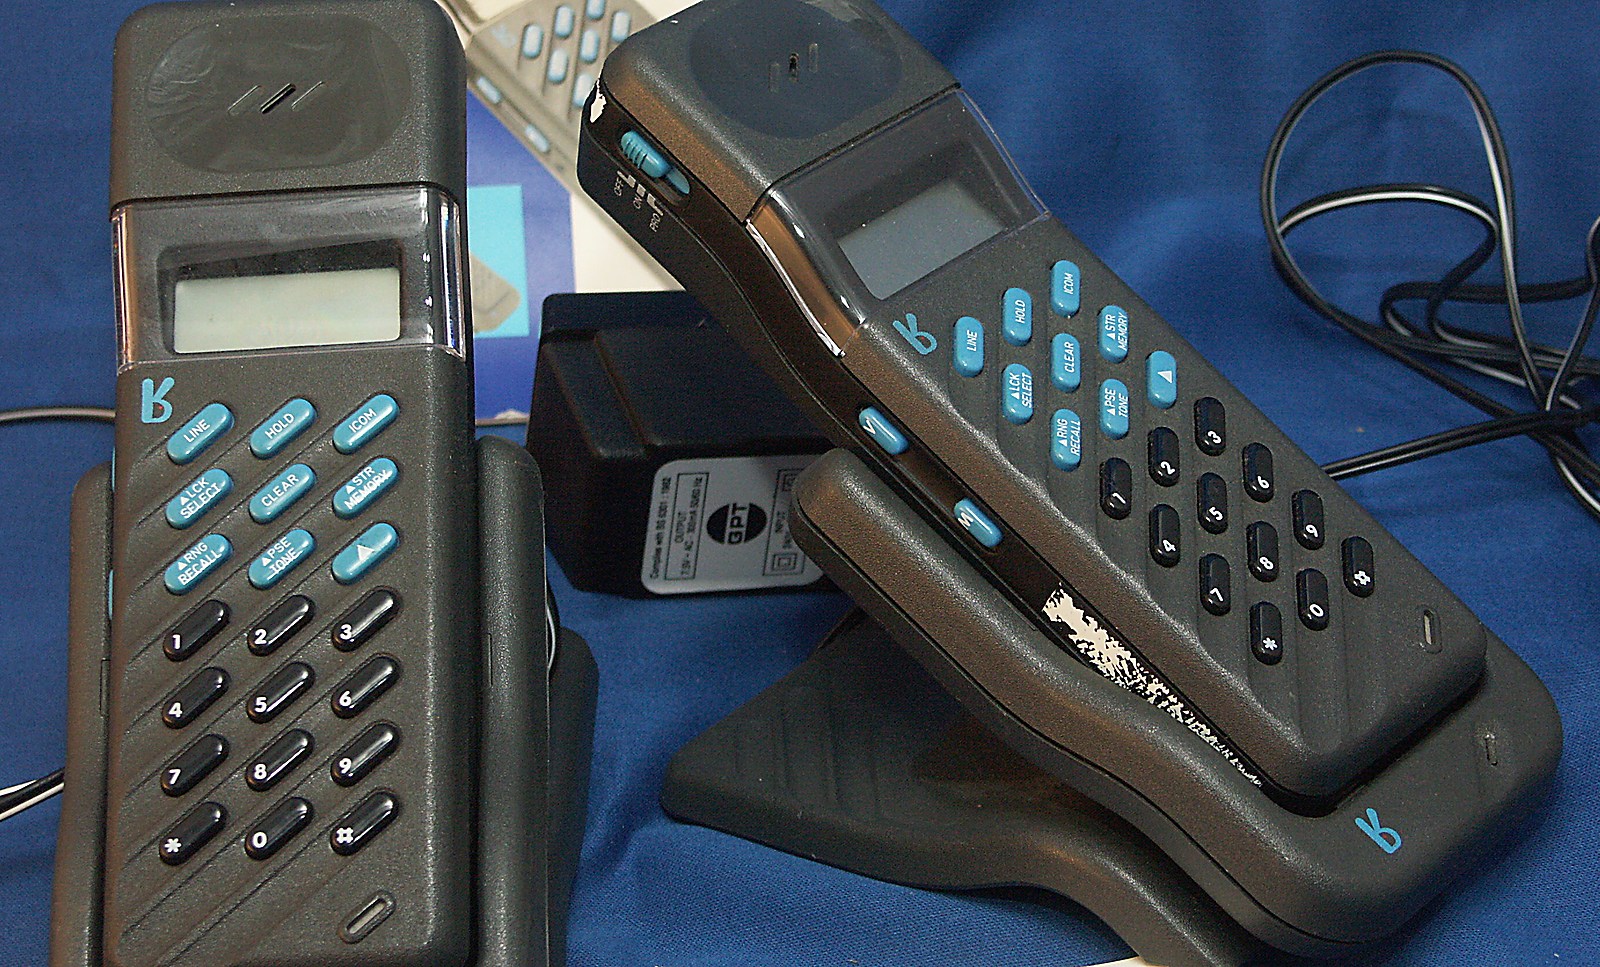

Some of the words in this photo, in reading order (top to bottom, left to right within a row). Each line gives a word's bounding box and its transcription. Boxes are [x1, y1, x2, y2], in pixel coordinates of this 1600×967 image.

[1063, 272, 1074, 295] ICOM
[1015, 299, 1026, 324] HOLD
[1117, 312, 1129, 351] MEMORY
[966, 330, 978, 352] LINE
[1064, 341, 1075, 373] CLEAR
[1022, 373, 1033, 408] SELECT
[1118, 393, 1129, 418] TONE
[264, 412, 295, 439] HOLD
[349, 408, 377, 434] ICOM
[183, 419, 211, 444] LINE
[1070, 420, 1081, 456] RECALL
[1207, 430, 1222, 445] 3
[1160, 461, 1176, 476] 2
[261, 474, 299, 508] CLEAR
[1258, 476, 1270, 489] 6
[1113, 491, 1127, 505] 1
[1209, 506, 1224, 521] 5
[728, 502, 748, 545] GPT
[1305, 524, 1318, 538] 9
[1162, 539, 1177, 553] 4
[177, 547, 223, 586] RECALL
[1259, 556, 1274, 571] 8
[1210, 587, 1225, 602] 7
[255, 630, 267, 645] 2
[340, 624, 352, 641] 3
[172, 634, 181, 650] 1
[255, 696, 267, 713] 5
[339, 690, 351, 706] 6
[168, 702, 182, 718] 4
[254, 763, 267, 779] 8
[339, 757, 351, 774] 9
[169, 769, 181, 785] 7
